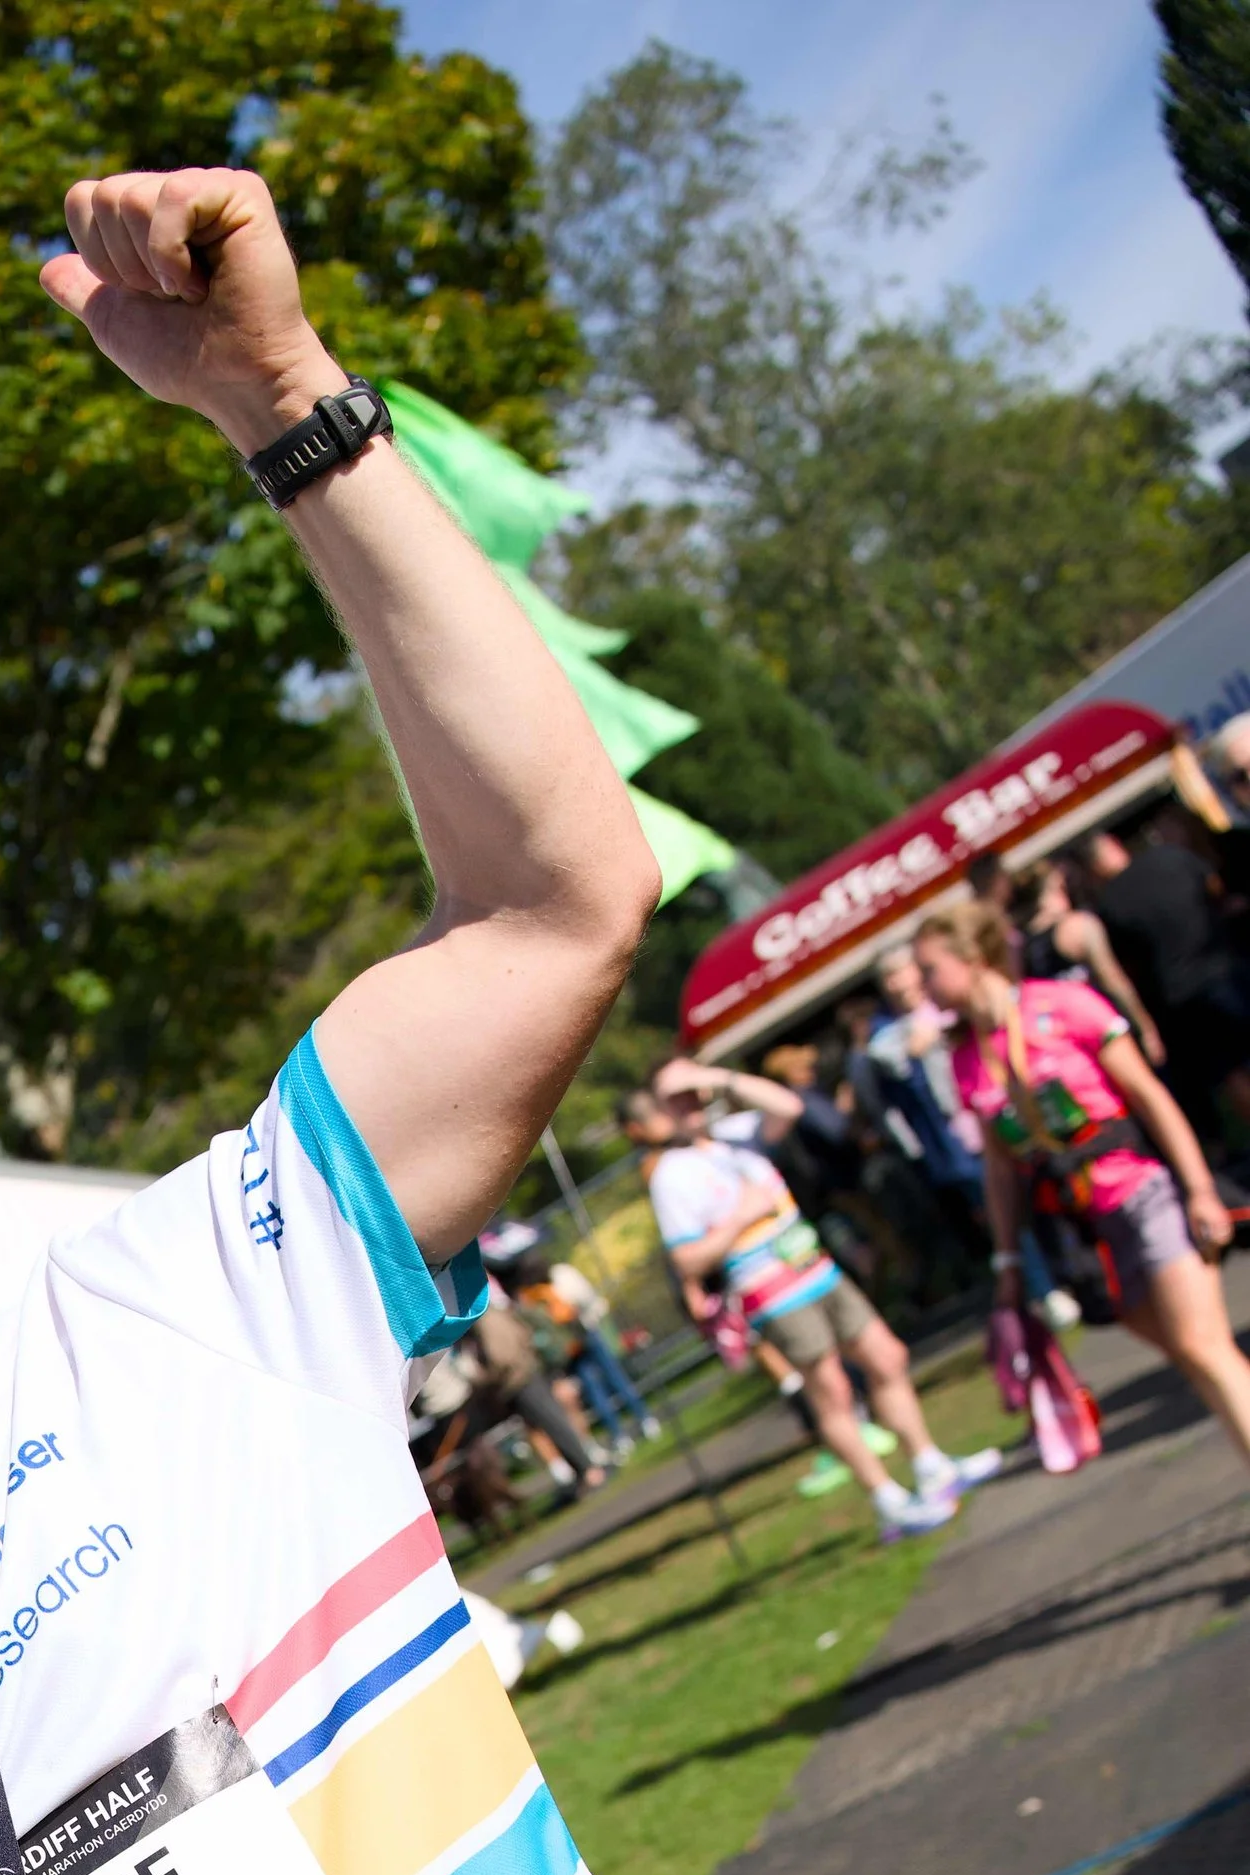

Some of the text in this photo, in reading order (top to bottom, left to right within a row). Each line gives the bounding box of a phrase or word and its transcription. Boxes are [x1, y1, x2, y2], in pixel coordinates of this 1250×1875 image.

[753, 832, 942, 962] Coffee
[942, 751, 1063, 840] Bar
[21, 1766, 154, 1875] DIFF HALF
[104, 1793, 168, 1840] CAERDYDD
